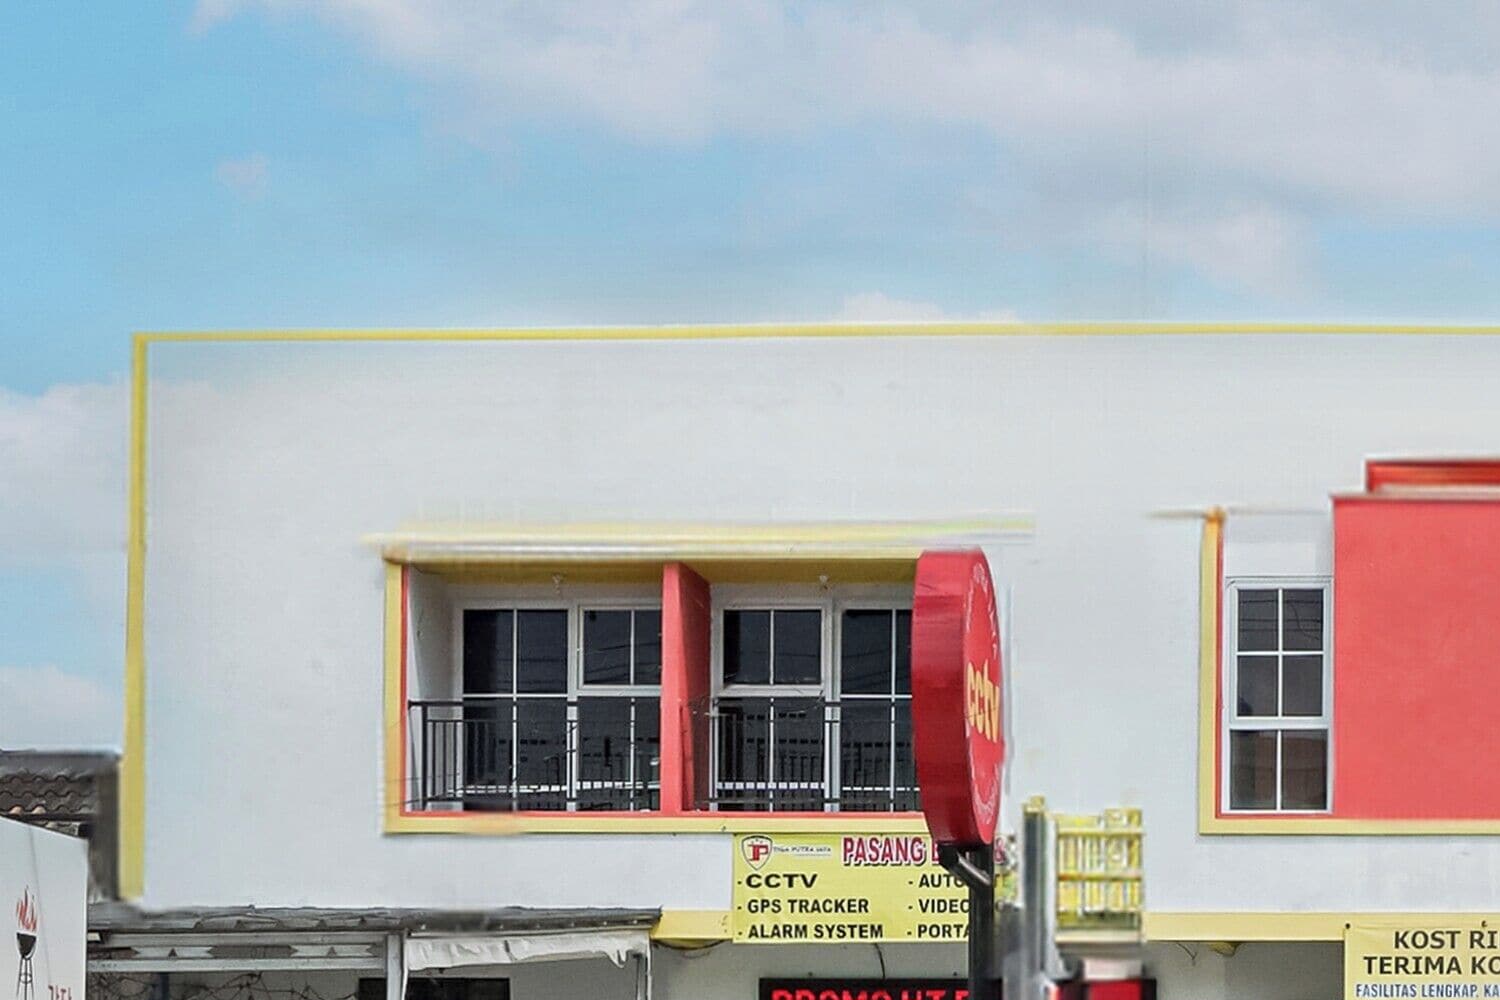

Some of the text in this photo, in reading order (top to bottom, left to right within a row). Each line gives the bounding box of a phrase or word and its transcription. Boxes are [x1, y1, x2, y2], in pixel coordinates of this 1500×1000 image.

[843, 836, 926, 866] PASANG
[745, 873, 818, 889] CCTV
[747, 898, 869, 914] GPS TRACKER
[748, 924, 884, 939] ALARM SYSTEM
[1394, 930, 1461, 949] KOST
[1363, 955, 1463, 975] TERIMA
[1356, 983, 1418, 998] FASILITAS
